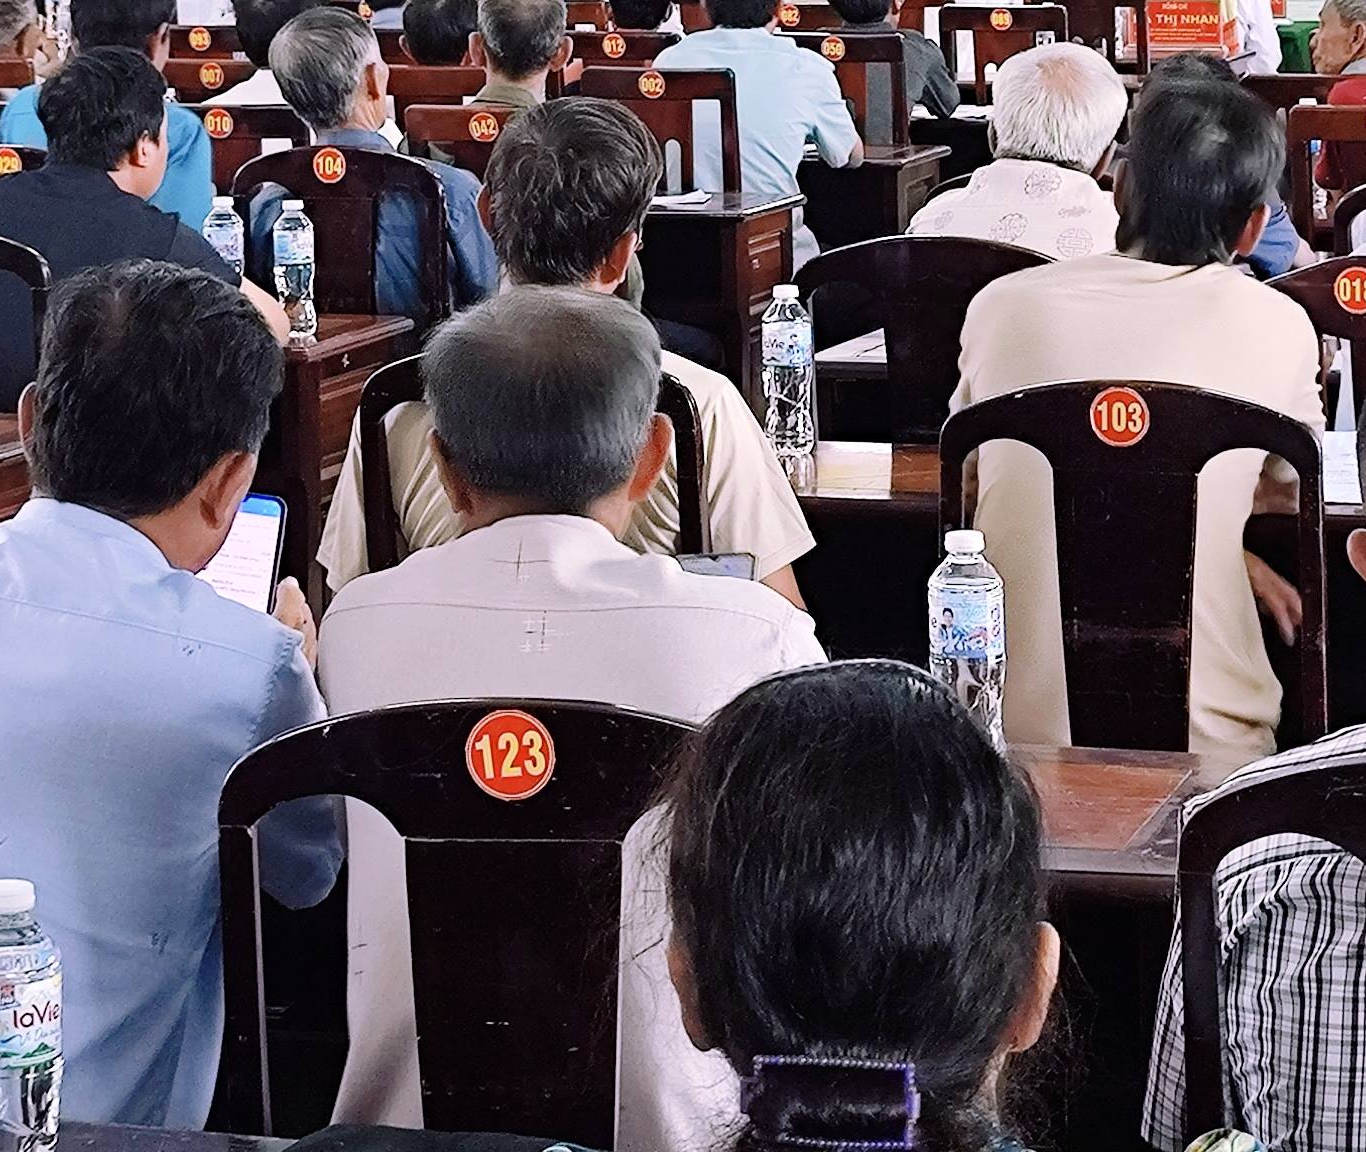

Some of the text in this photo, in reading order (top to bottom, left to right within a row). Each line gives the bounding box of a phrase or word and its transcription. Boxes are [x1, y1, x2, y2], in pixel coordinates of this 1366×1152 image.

[603, 35, 625, 54] 012
[640, 74, 665, 94] 002
[207, 112, 232, 134] 010
[471, 116, 497, 138] 042
[317, 154, 344, 176] 104
[1096, 400, 1145, 433] 103
[475, 735, 547, 779] 123
